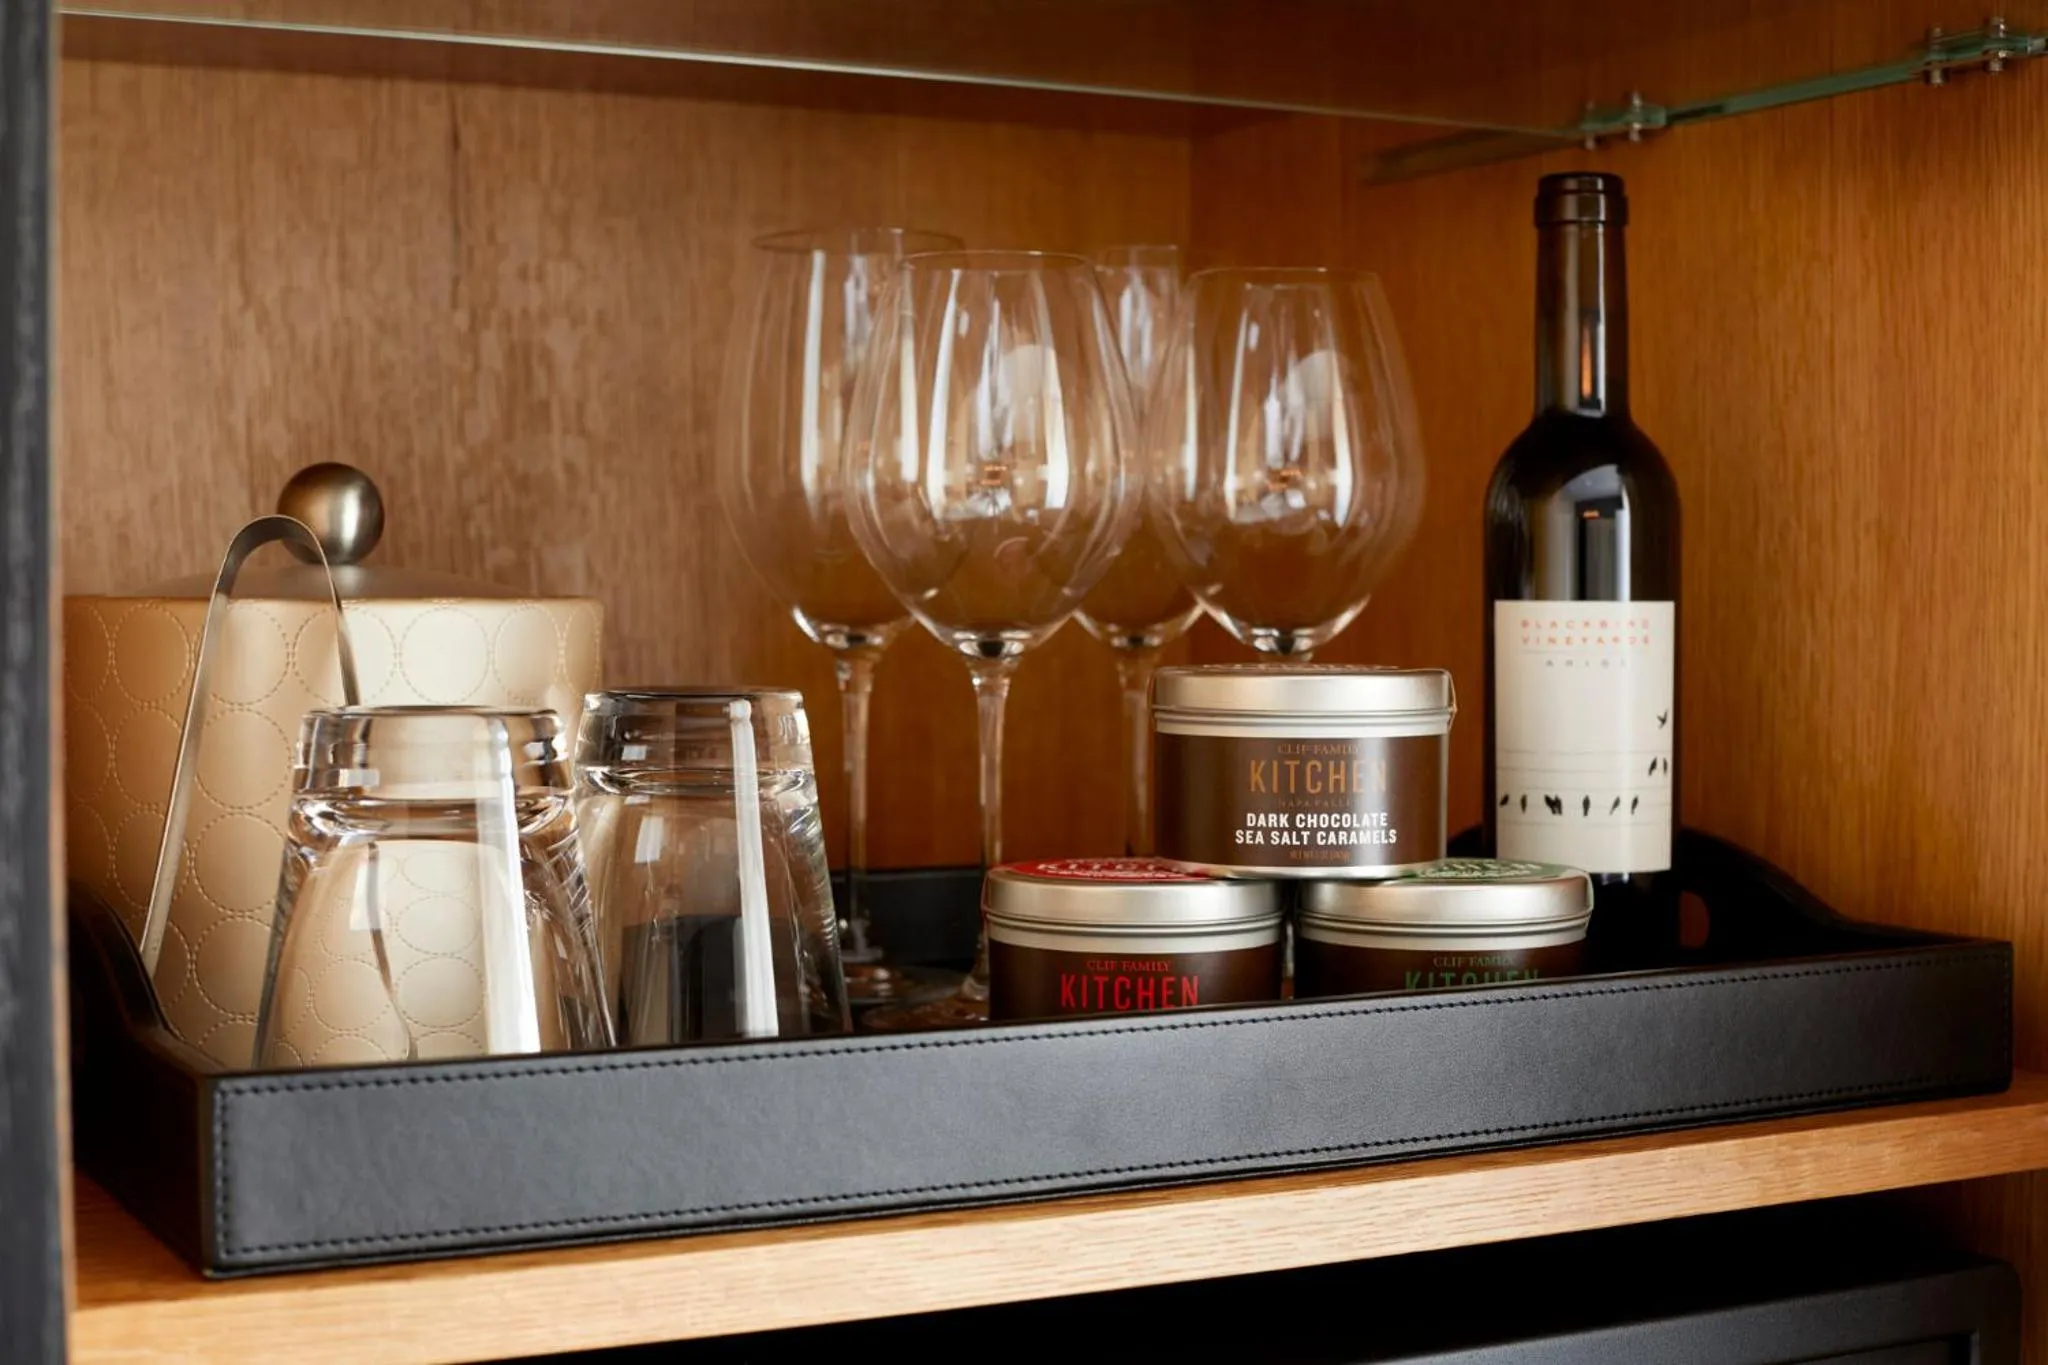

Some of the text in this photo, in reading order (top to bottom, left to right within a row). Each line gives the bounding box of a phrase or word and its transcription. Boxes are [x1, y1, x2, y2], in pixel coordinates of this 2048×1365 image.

[1249, 759, 1387, 794] KITCHEN
[1246, 812, 1388, 829] DARK CHOCOLATE
[1235, 829, 1397, 846] SEA SALT CARAMELS
[1087, 959, 1172, 971] CLIF FAMILY
[1060, 974, 1200, 1013] KITCHEN
